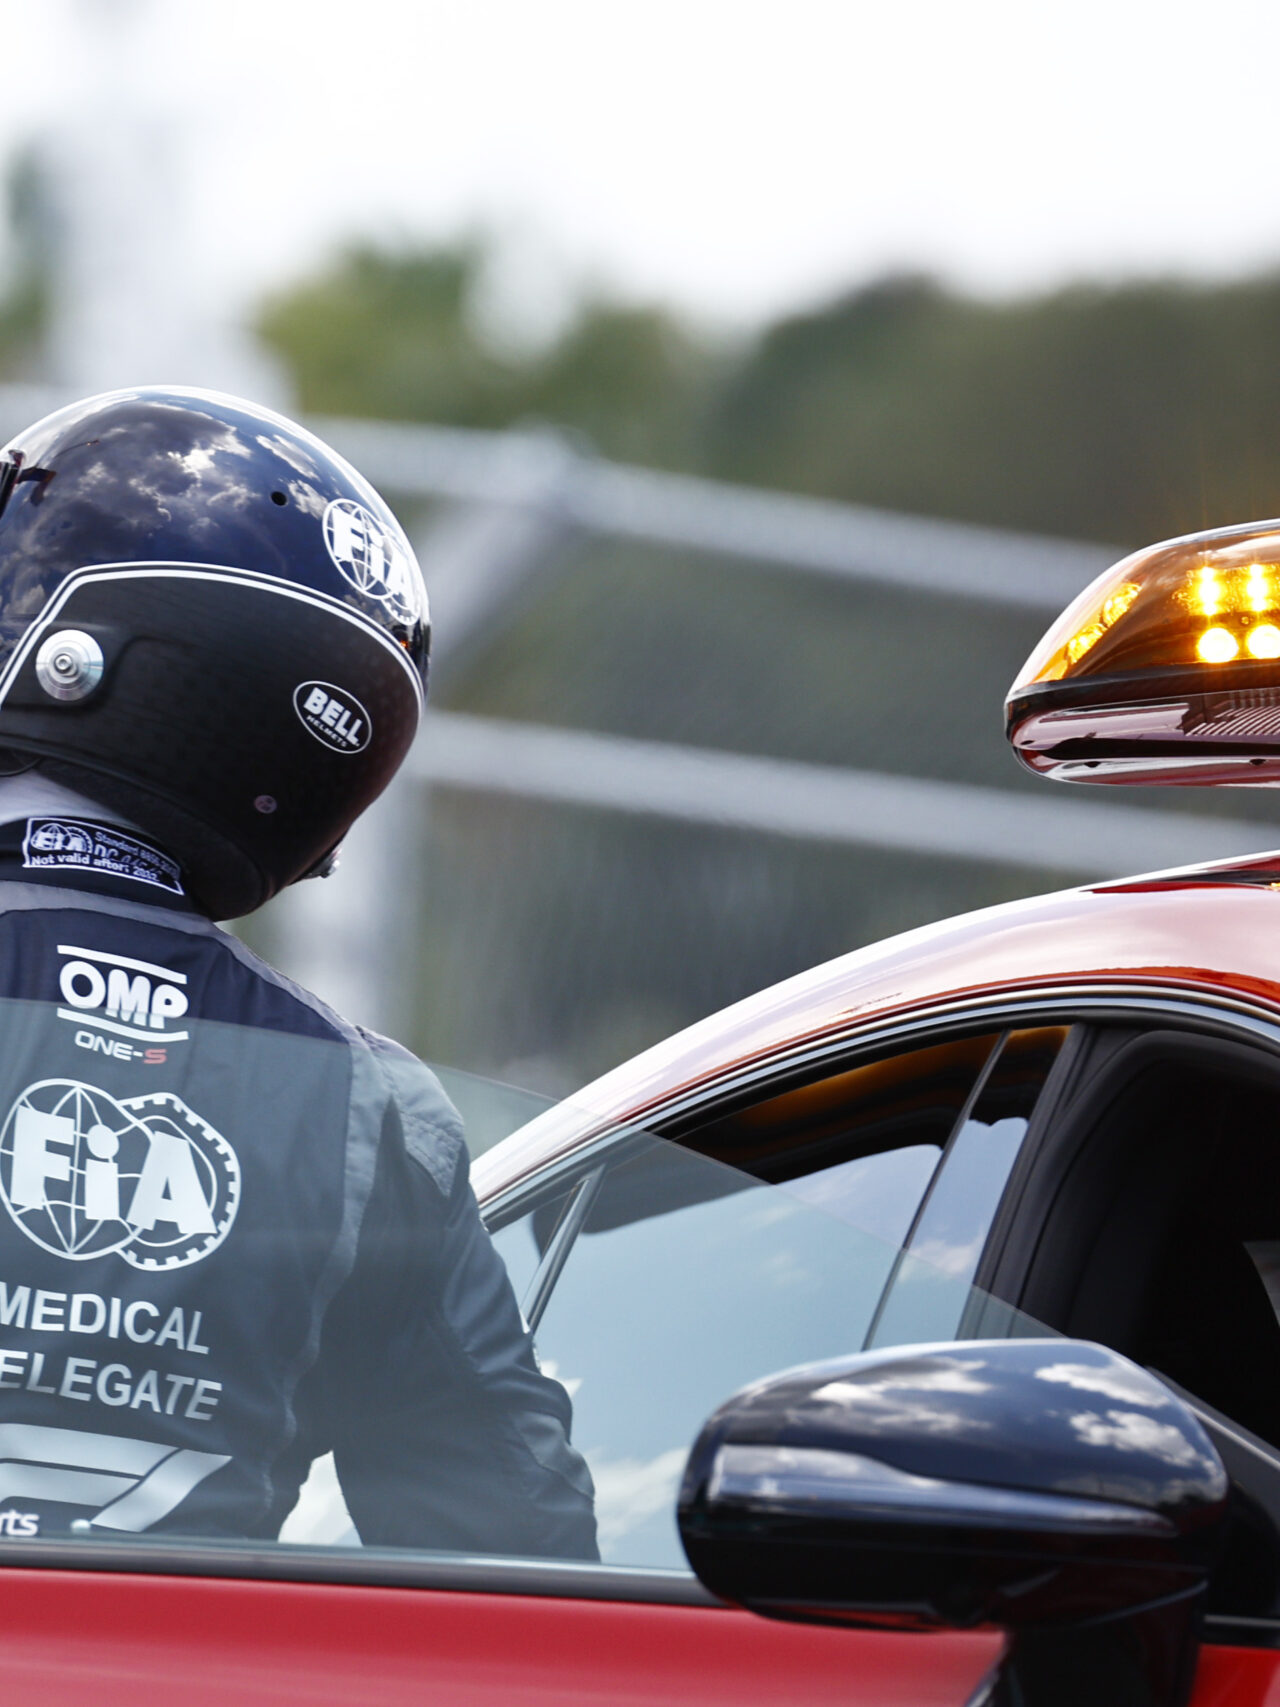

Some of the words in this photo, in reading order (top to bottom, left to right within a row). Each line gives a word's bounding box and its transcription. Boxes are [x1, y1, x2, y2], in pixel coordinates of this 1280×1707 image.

[303, 686, 363, 745] BELL
[31, 855, 55, 866] Not
[57, 853, 90, 865] valid
[59, 960, 189, 1030] OMP
[74, 1030, 168, 1065] ONE-S
